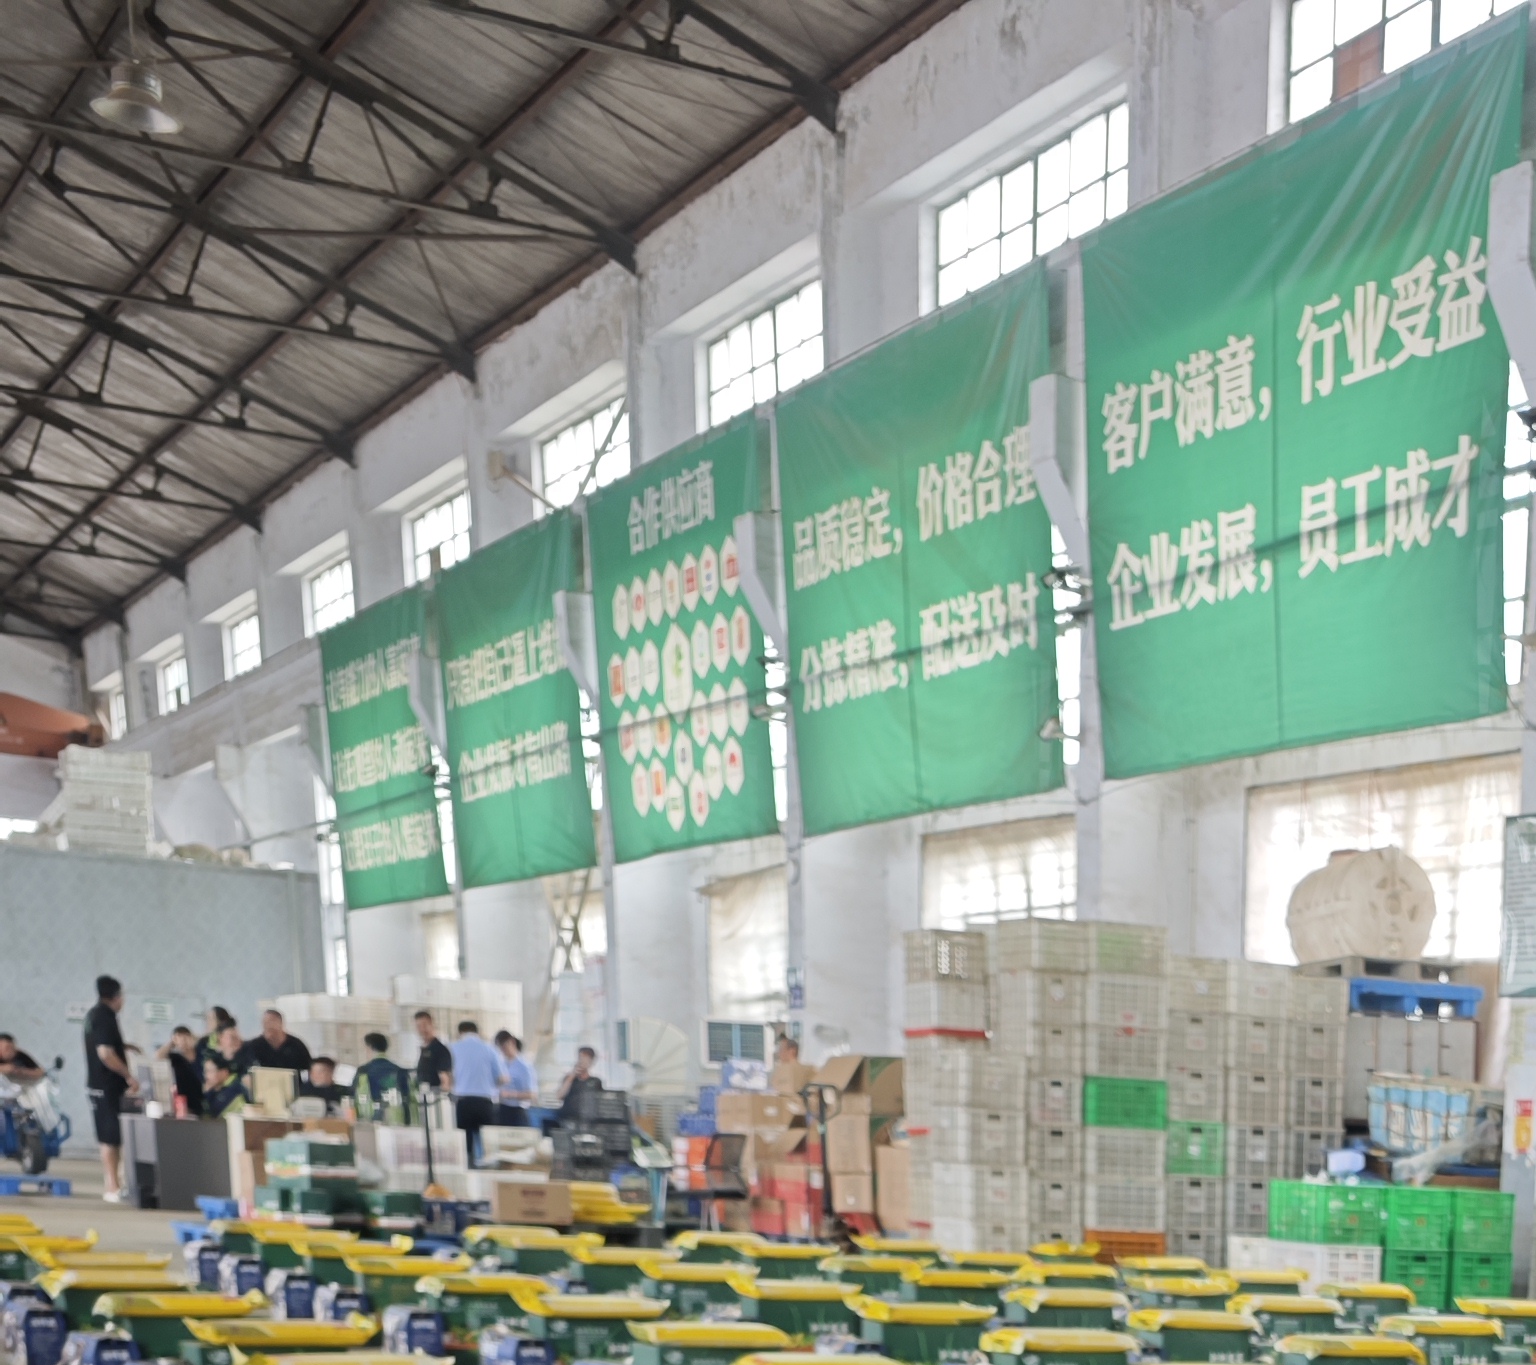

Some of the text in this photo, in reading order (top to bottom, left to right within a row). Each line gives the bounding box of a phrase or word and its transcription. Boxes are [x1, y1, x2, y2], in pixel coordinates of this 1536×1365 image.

[628, 460, 715, 555] 合作供应商
